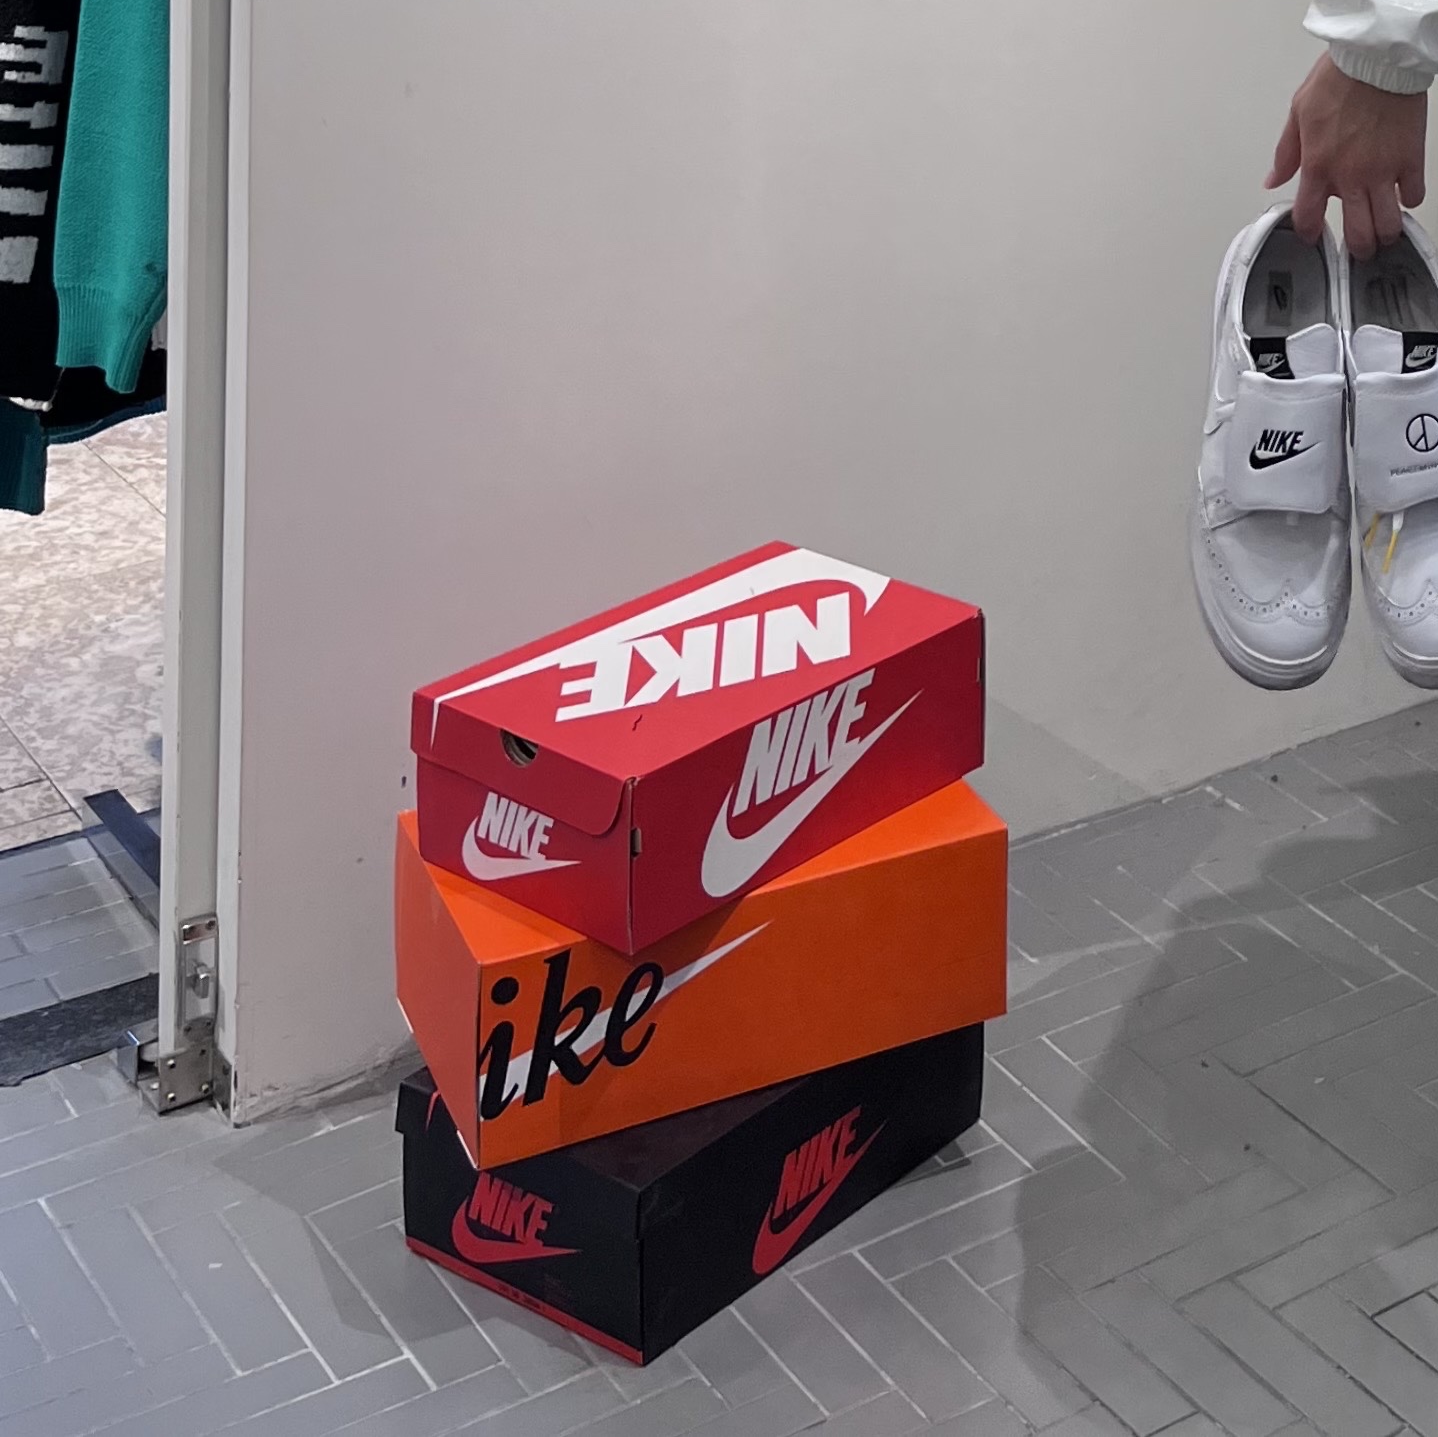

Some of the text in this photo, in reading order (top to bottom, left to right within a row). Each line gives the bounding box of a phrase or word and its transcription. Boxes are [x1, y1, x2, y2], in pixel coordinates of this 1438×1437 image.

[1256, 428, 1304, 454] NIKE
[554, 592, 850, 722] NIKE
[732, 668, 876, 816] NIKE
[476, 793, 555, 860] NIKE
[467, 1172, 555, 1246] NIKE
[771, 1106, 863, 1219] NIKE
